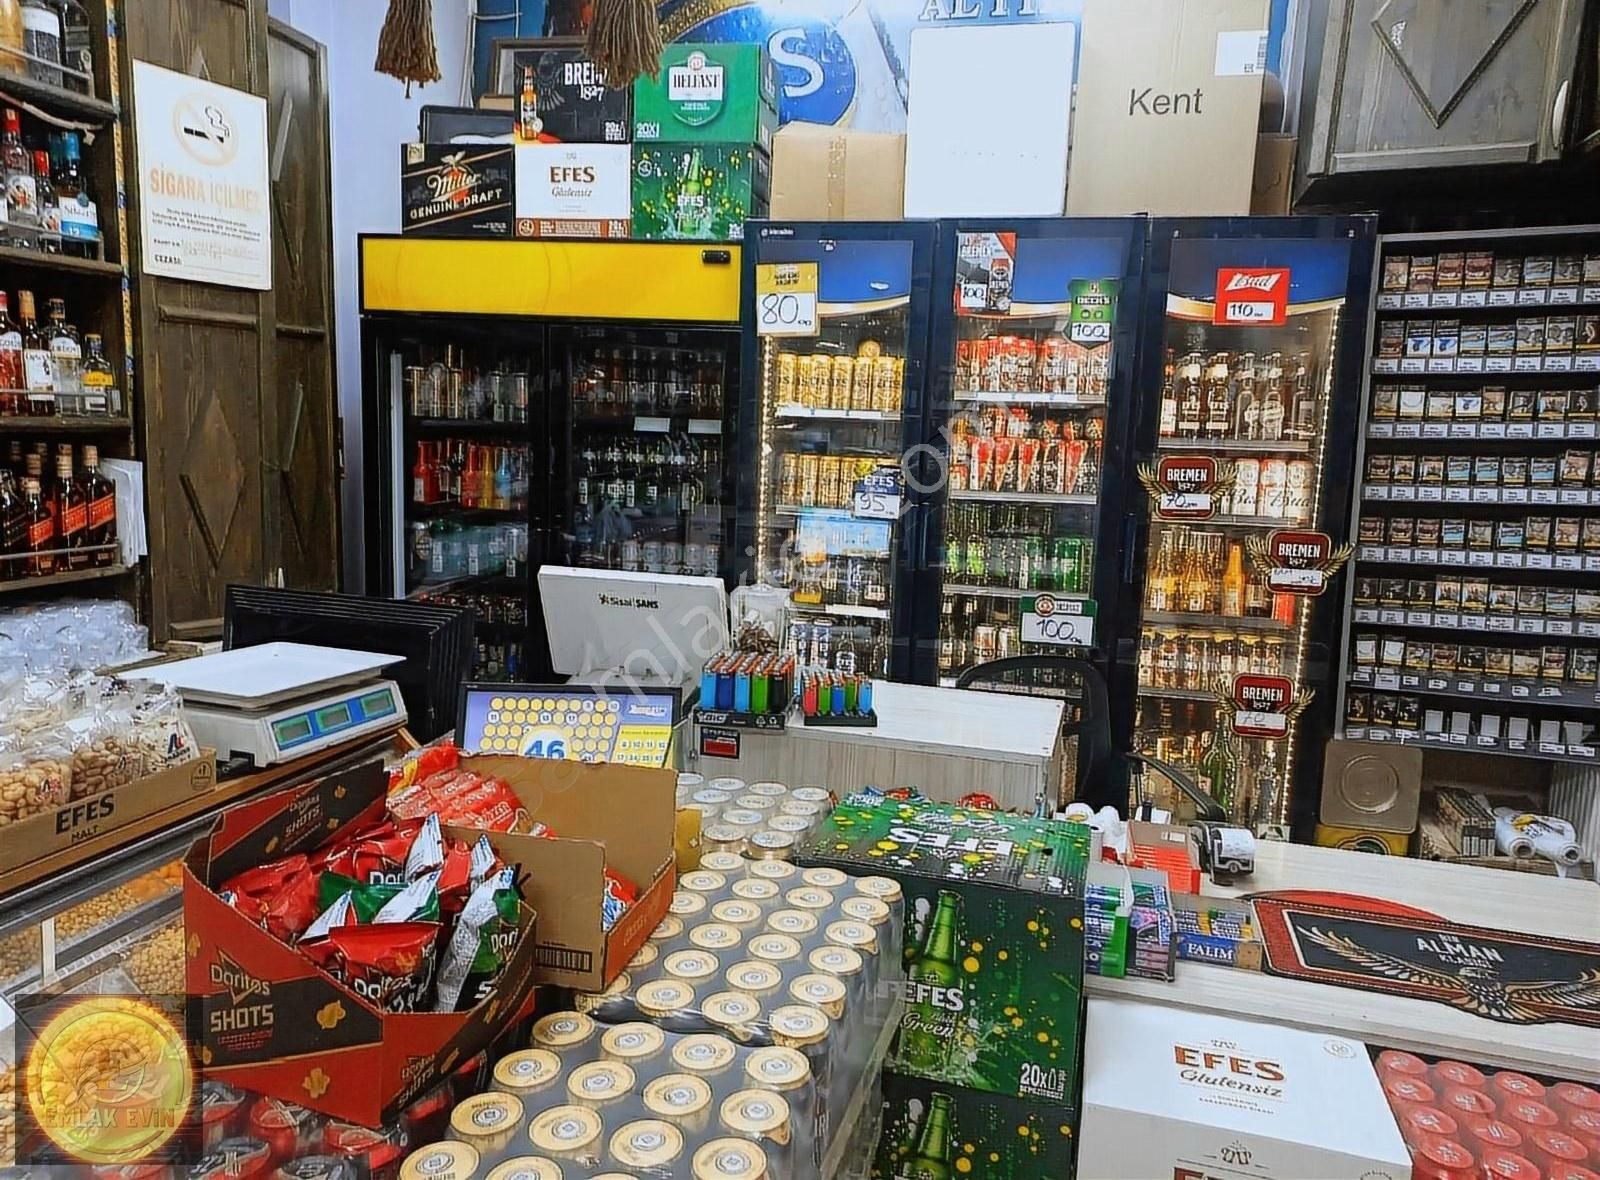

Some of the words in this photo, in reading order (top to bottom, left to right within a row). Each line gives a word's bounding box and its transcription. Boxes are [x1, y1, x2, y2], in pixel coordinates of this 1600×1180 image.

[1129, 88, 1203, 116] Kent
[427, 172, 480, 197] Miller
[550, 166, 595, 184] EFES
[464, 188, 503, 208] DRAFT
[762, 293, 799, 324] 80
[863, 475, 895, 487] EFES
[1166, 468, 1208, 482] BREMEN
[1278, 543, 1321, 558] BREMEN
[1242, 686, 1284, 701] BREMEN
[524, 740, 565, 761] 46
[56, 793, 115, 835] EFES
[71, 825, 100, 844] MALT
[887, 827, 1014, 856] EFES
[1416, 937, 1505, 963] ALMAN
[211, 964, 271, 996] Doritos
[905, 981, 964, 1012] EFES
[210, 1003, 275, 1033] SHOTS
[902, 1012, 956, 1038] Green
[1174, 1045, 1285, 1082] EFES
[1180, 1069, 1283, 1098] Glutensiz
